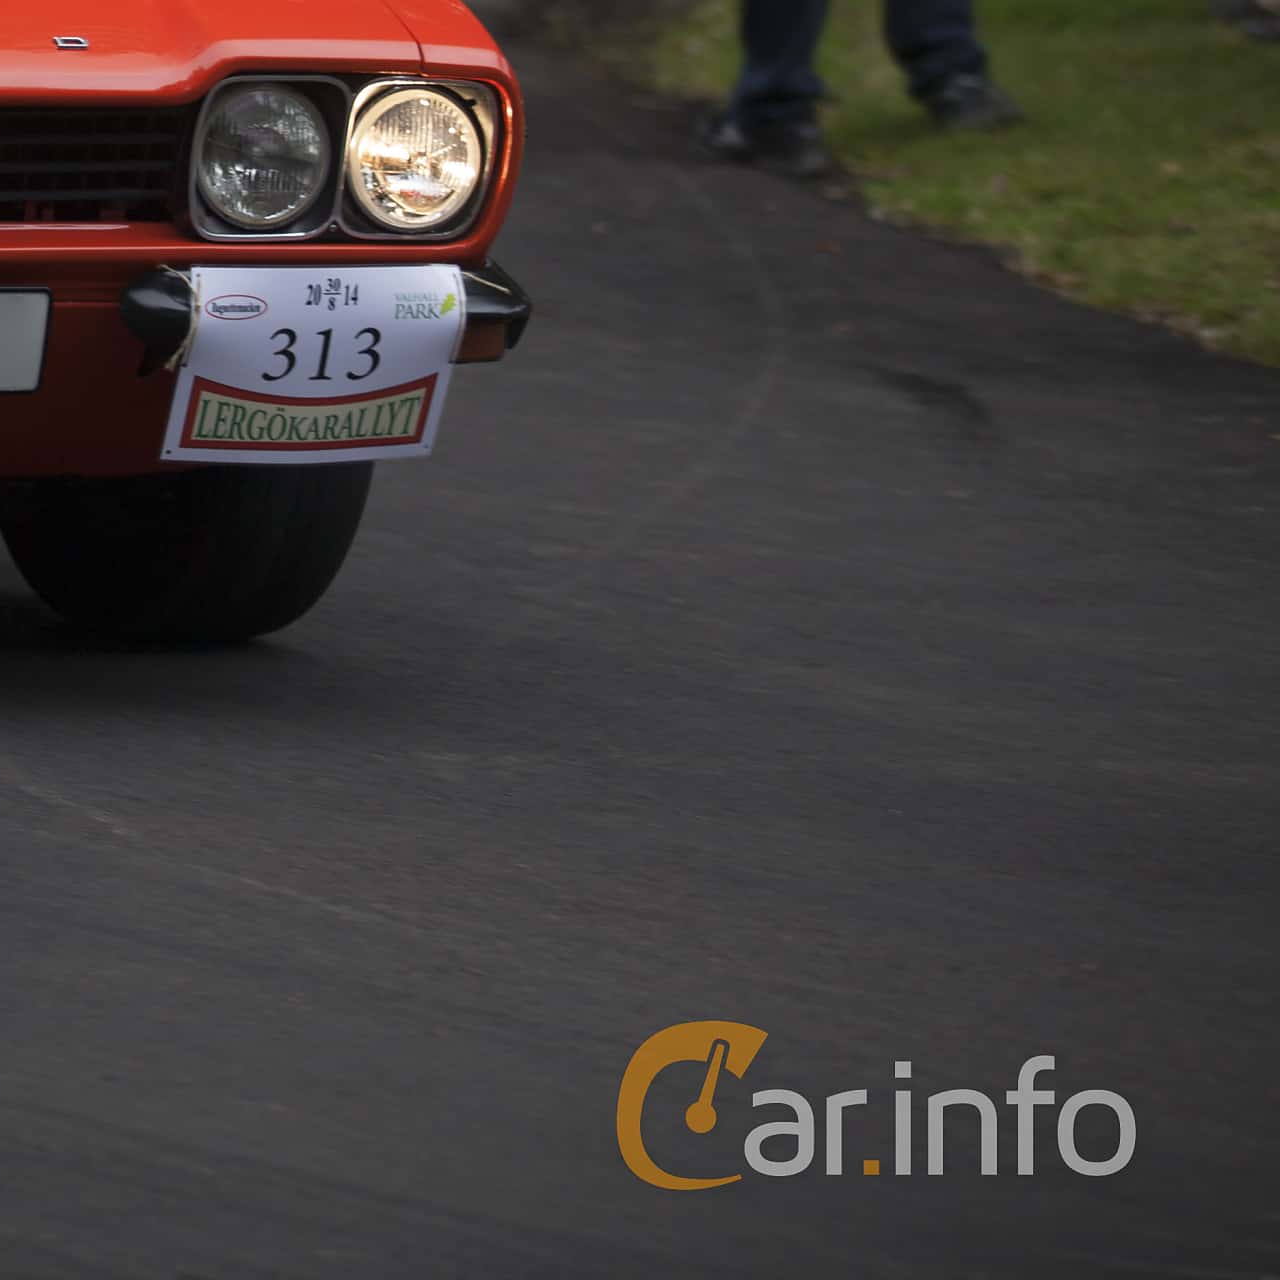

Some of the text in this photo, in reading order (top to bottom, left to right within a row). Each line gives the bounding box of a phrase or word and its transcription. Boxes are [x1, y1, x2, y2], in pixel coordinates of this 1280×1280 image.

[305, 283, 359, 306] 20 14
[325, 278, 341, 292] 30
[327, 297, 337, 311] 8
[394, 303, 440, 320] PARK
[261, 327, 382, 381] 313
[194, 395, 422, 442] LERGÖKARALLYT
